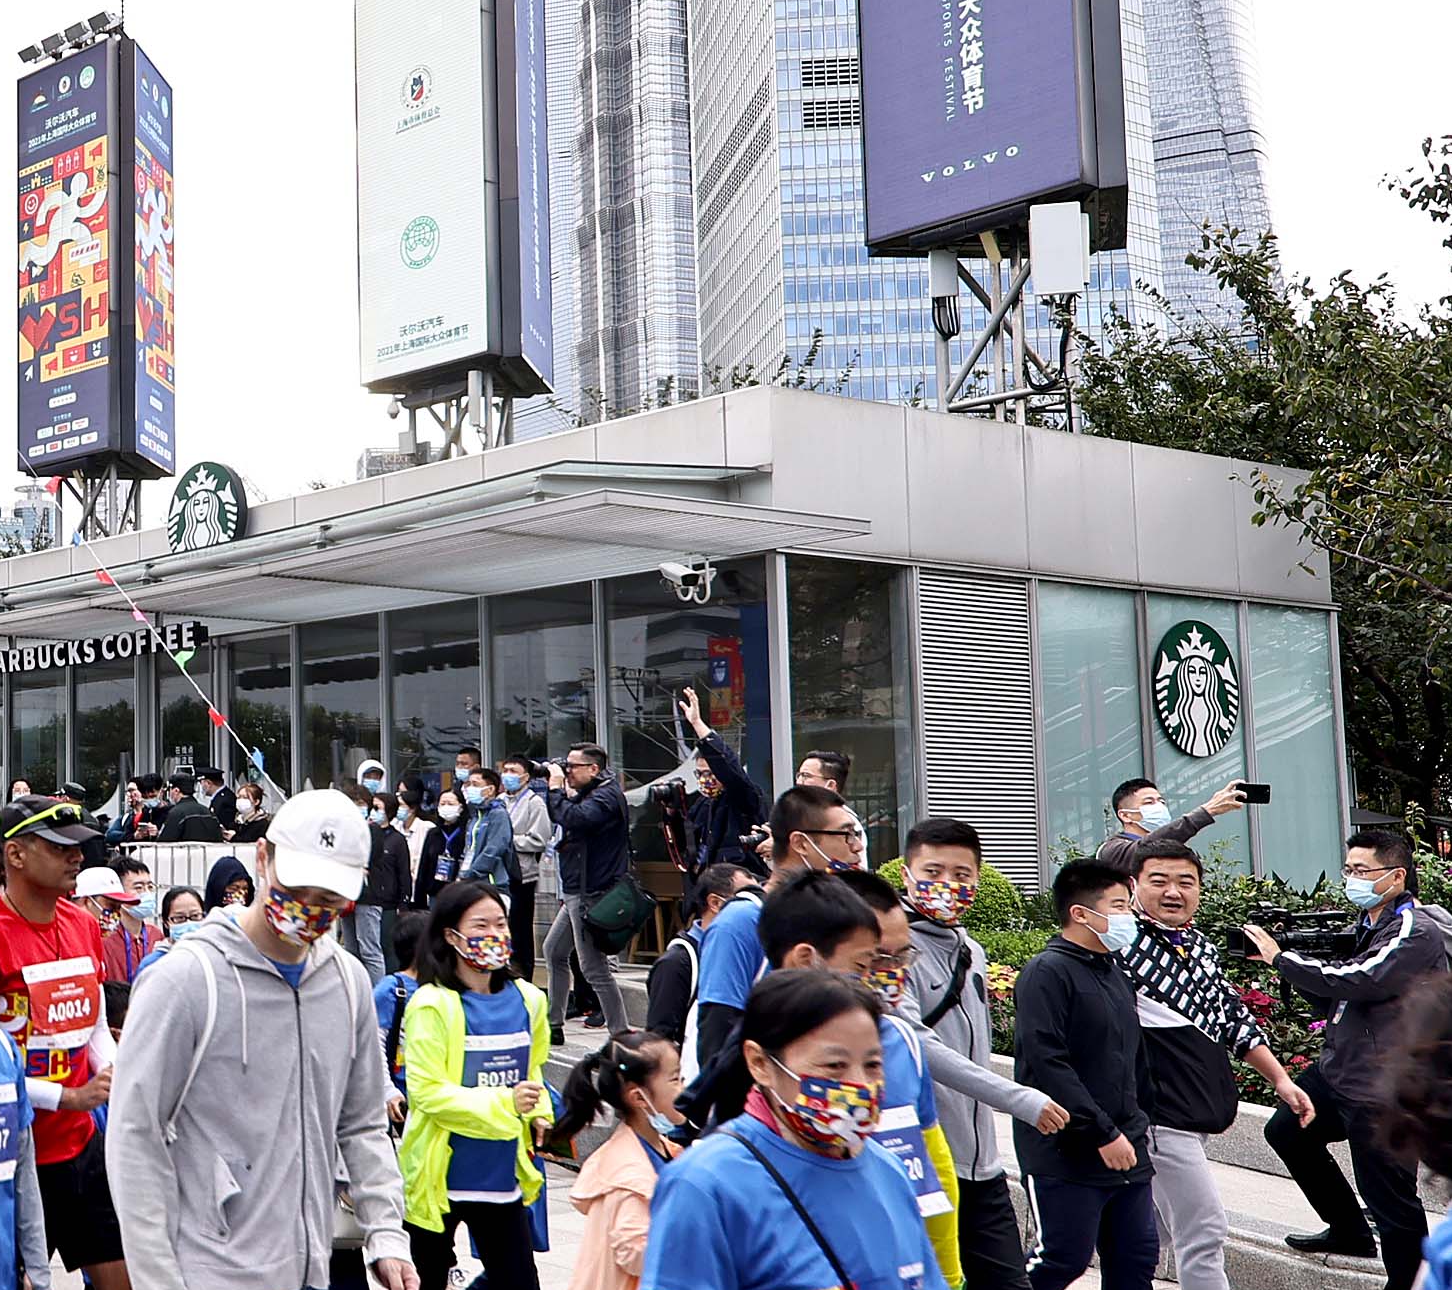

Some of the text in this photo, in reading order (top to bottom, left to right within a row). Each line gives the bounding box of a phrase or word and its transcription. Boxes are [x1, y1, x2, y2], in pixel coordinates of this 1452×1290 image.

[945, 58, 956, 121] FESTIVAL
[922, 145, 1020, 183] VOLVO
[101, 621, 195, 662] COFFEE
[48, 997, 91, 1024] A0014
